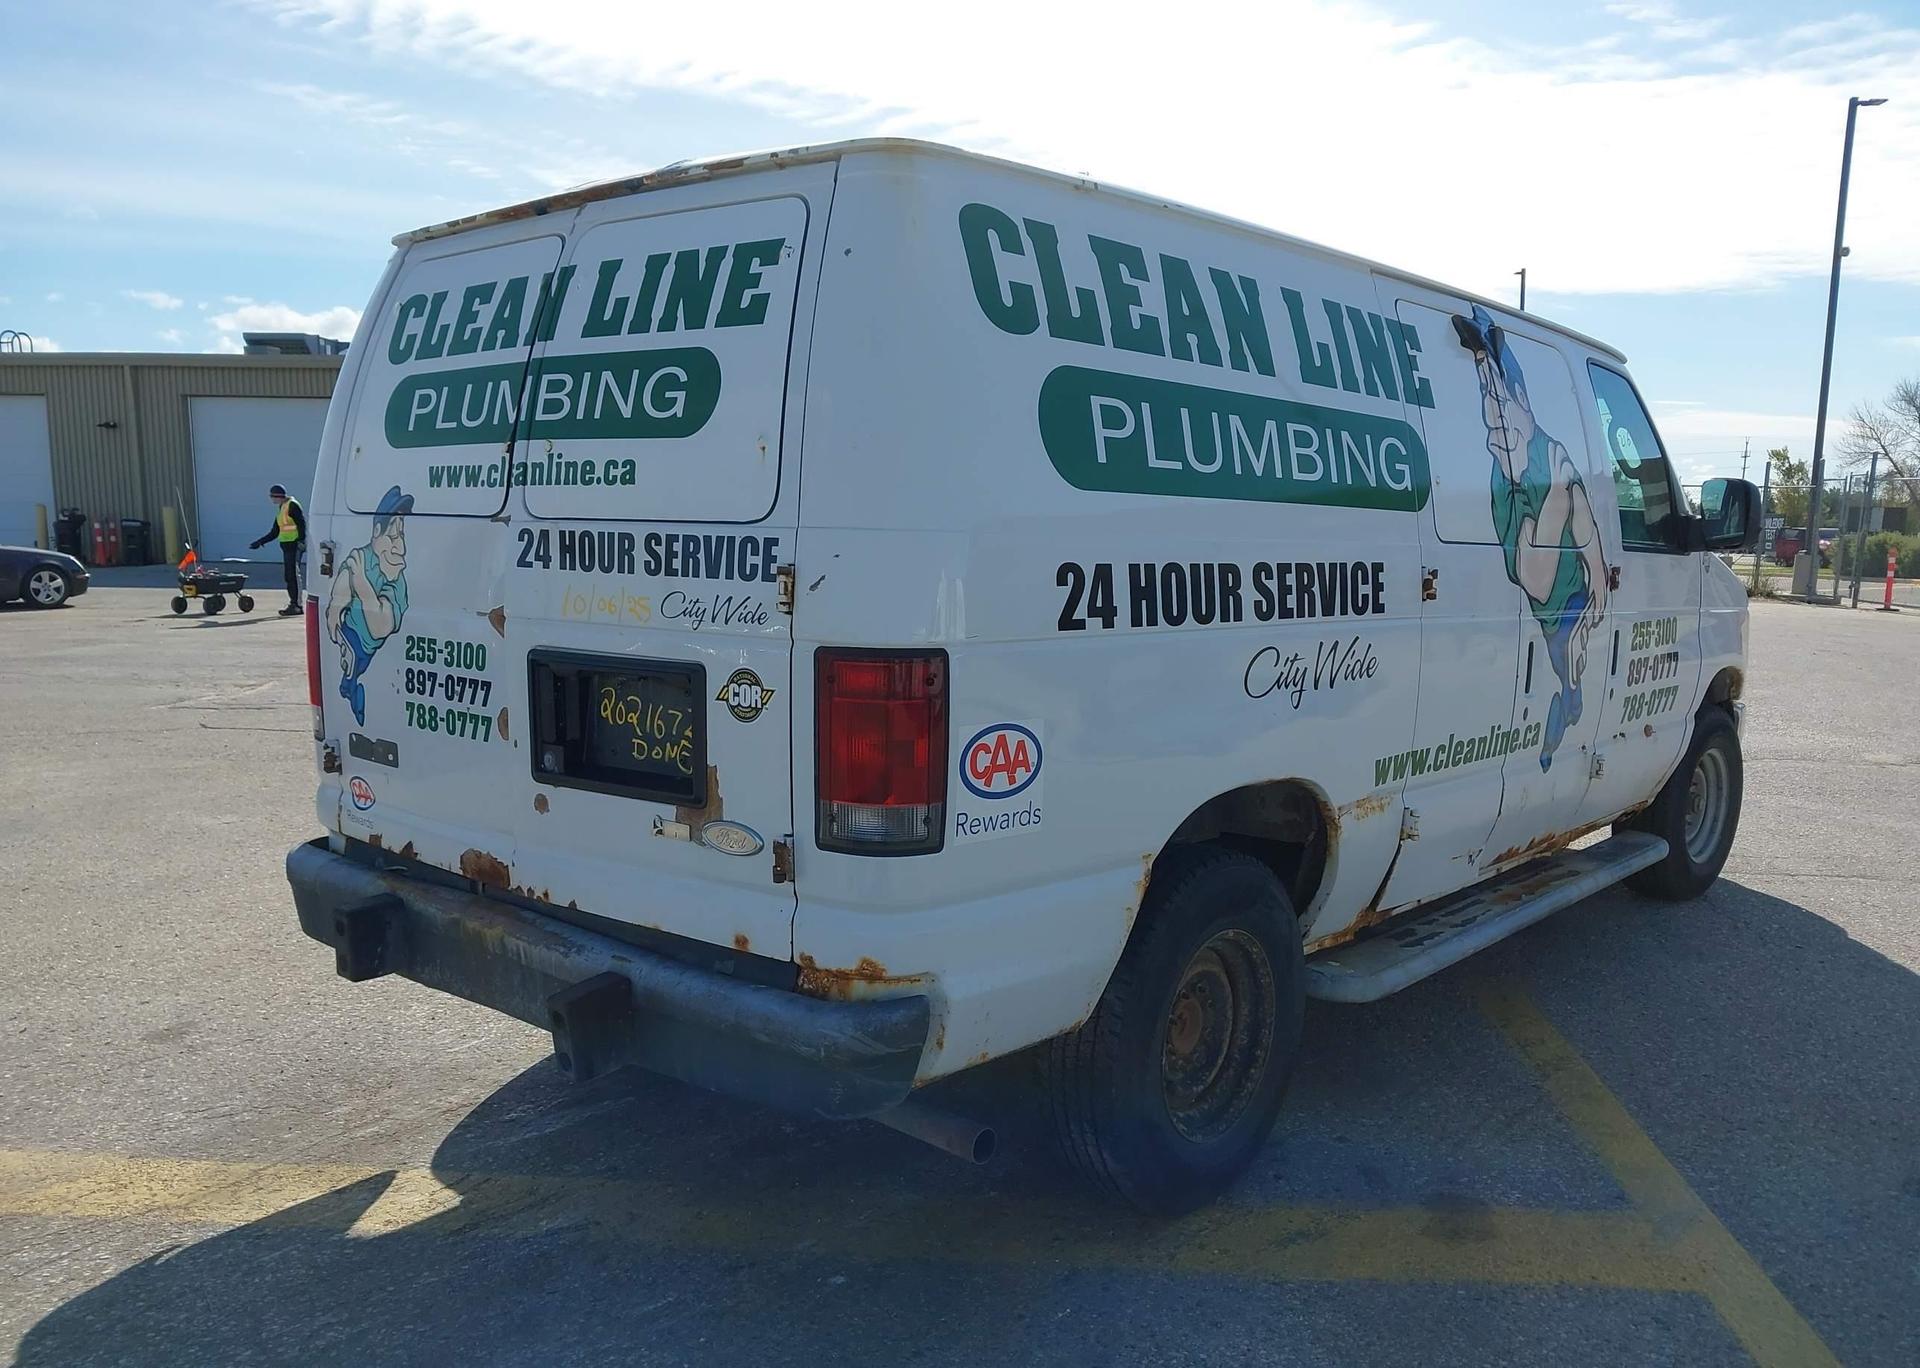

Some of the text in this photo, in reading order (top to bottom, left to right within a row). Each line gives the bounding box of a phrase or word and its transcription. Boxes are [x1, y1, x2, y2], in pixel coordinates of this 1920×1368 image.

[388, 237, 787, 366] CLEAN LINE
[958, 203, 1436, 409] CLEAN LINE
[408, 366, 689, 431] PLUMBING
[1089, 394, 1413, 492] PLUMBING
[516, 528, 780, 583] 24 HOUR SERVICE
[660, 590, 770, 631] City Wide
[1056, 560, 1385, 631] 24 HOUR SERVICE
[405, 634, 487, 672] 255-3100
[1630, 616, 1678, 652] 255-3100
[405, 667, 492, 707] 897-0777
[1243, 635, 1380, 710] City Wide
[1626, 651, 1679, 688] 897-0777
[728, 682, 763, 709] COR
[1620, 685, 1680, 725] 788-0777
[405, 701, 493, 743] 788-0777
[968, 733, 1032, 788] CAA
[1374, 721, 1542, 787] www.cleanline.ca
[352, 781, 373, 806] CAA
[715, 827, 747, 851] Ford
[955, 801, 1042, 838] Rewards
